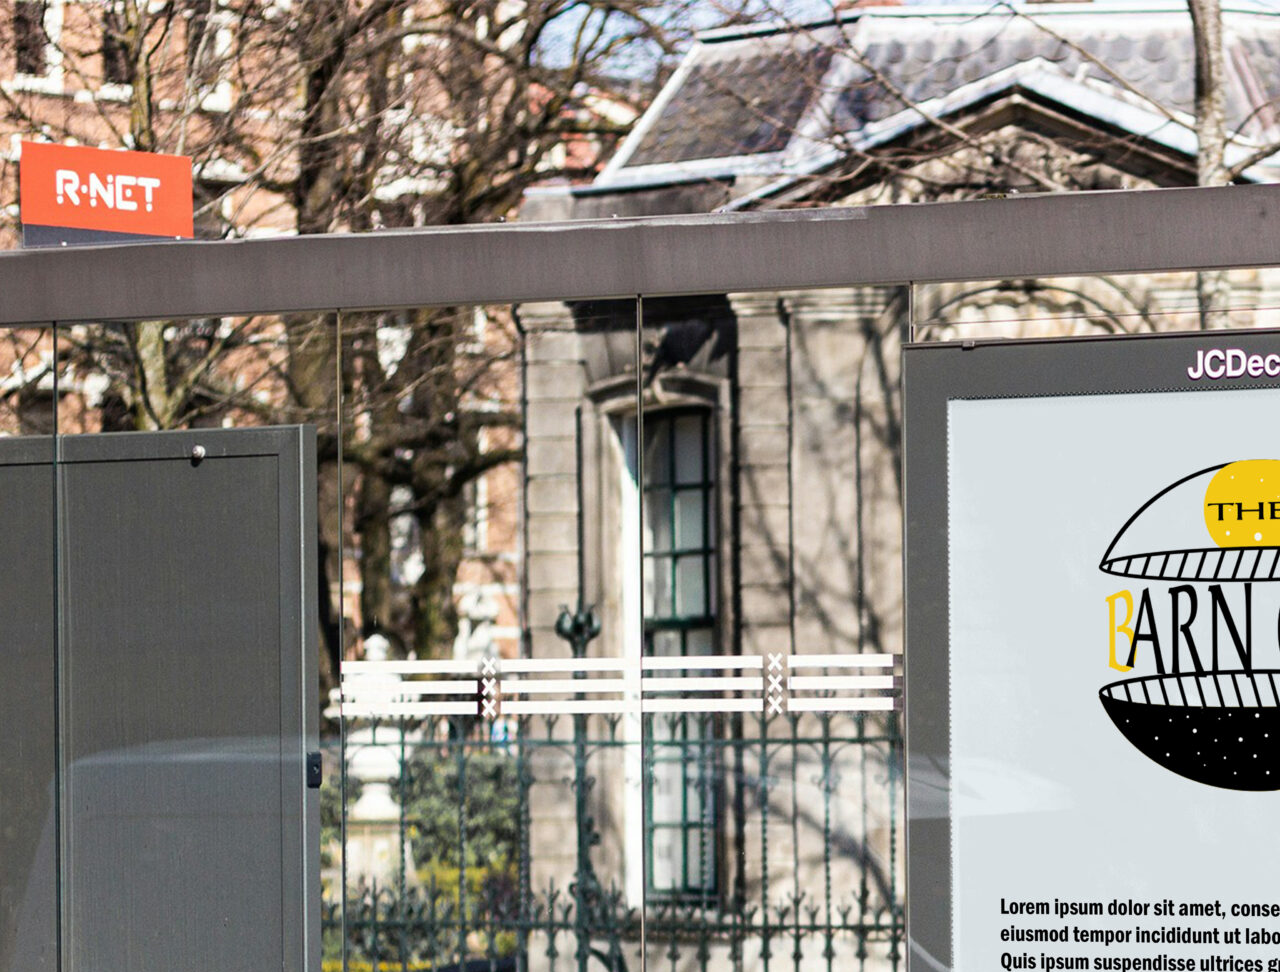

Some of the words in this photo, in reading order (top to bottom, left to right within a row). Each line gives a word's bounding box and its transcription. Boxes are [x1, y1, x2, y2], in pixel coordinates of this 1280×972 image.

[1104, 582, 1253, 677] BARN
[1000, 897, 1050, 915] Lorem
[1054, 898, 1104, 919] ipsum
[1107, 898, 1151, 916] dolor
[1153, 898, 1176, 917] sit
[1178, 899, 1226, 920] amet,
[1000, 924, 1069, 943] eiusmod
[1072, 926, 1133, 947] tempor
[1135, 926, 1220, 945] incididunt
[1223, 927, 1242, 945] ut
[1000, 952, 1037, 972] Quis
[1199, 954, 1264, 972] ultrices
